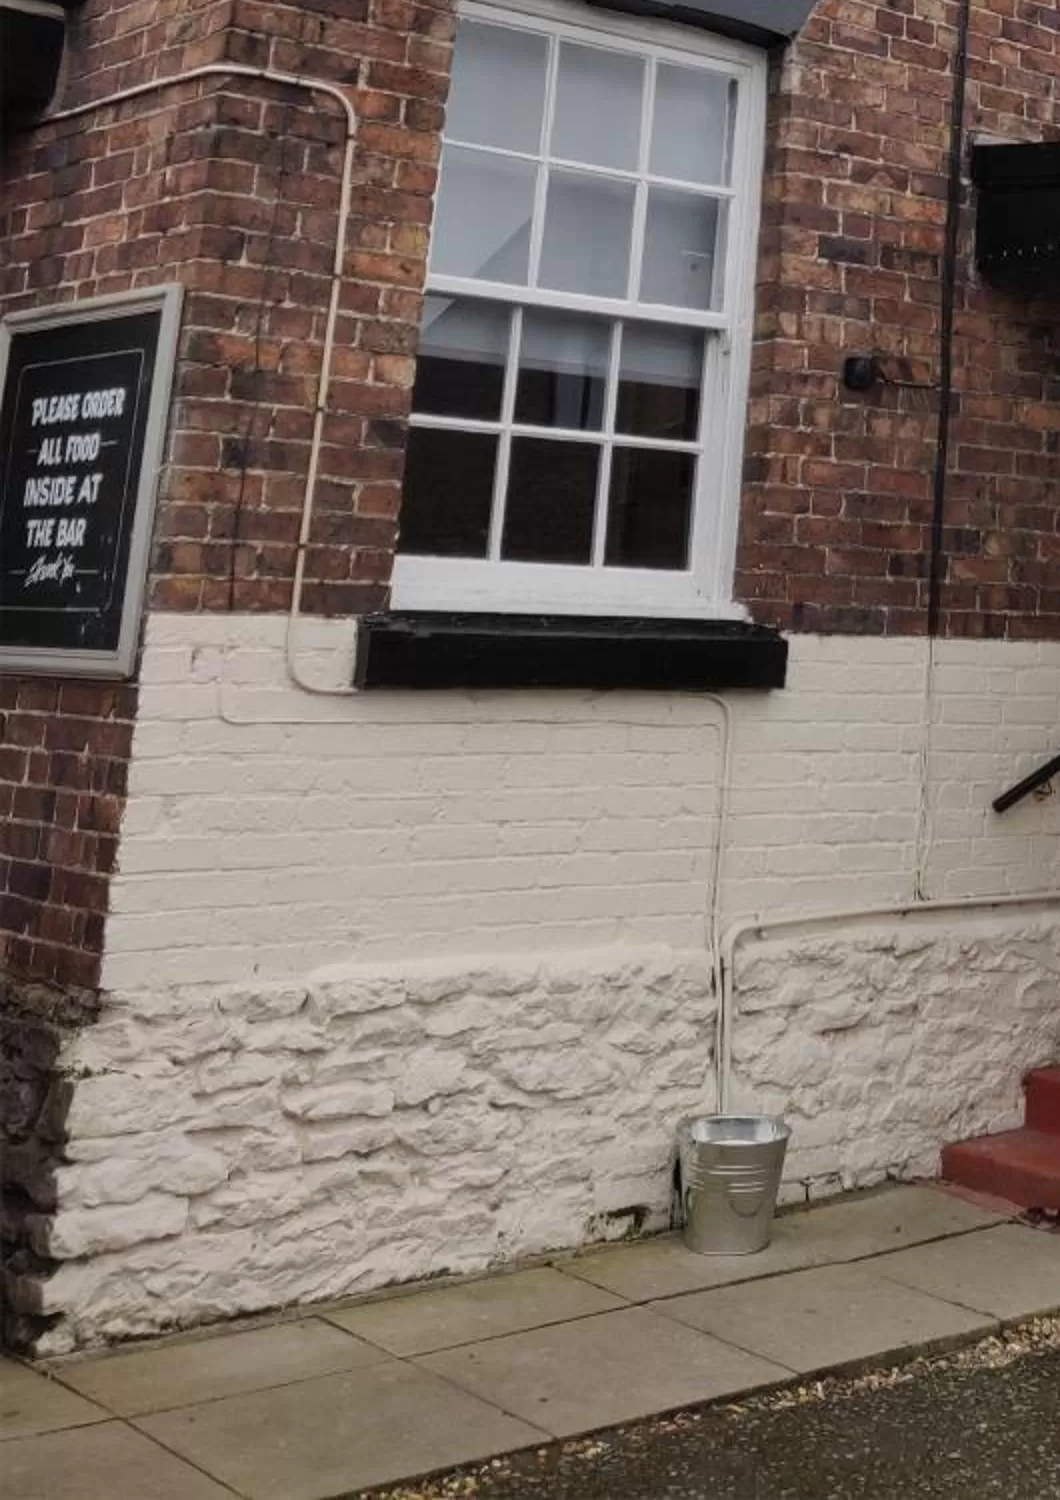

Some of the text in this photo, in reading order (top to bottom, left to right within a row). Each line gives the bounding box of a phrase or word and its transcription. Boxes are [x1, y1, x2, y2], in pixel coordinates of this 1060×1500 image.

[31, 387, 126, 427] PLEASE ORDER
[37, 432, 101, 466] ALL FOOD
[23, 472, 104, 507] INSIDE AT
[26, 518, 87, 548] THE BAR
